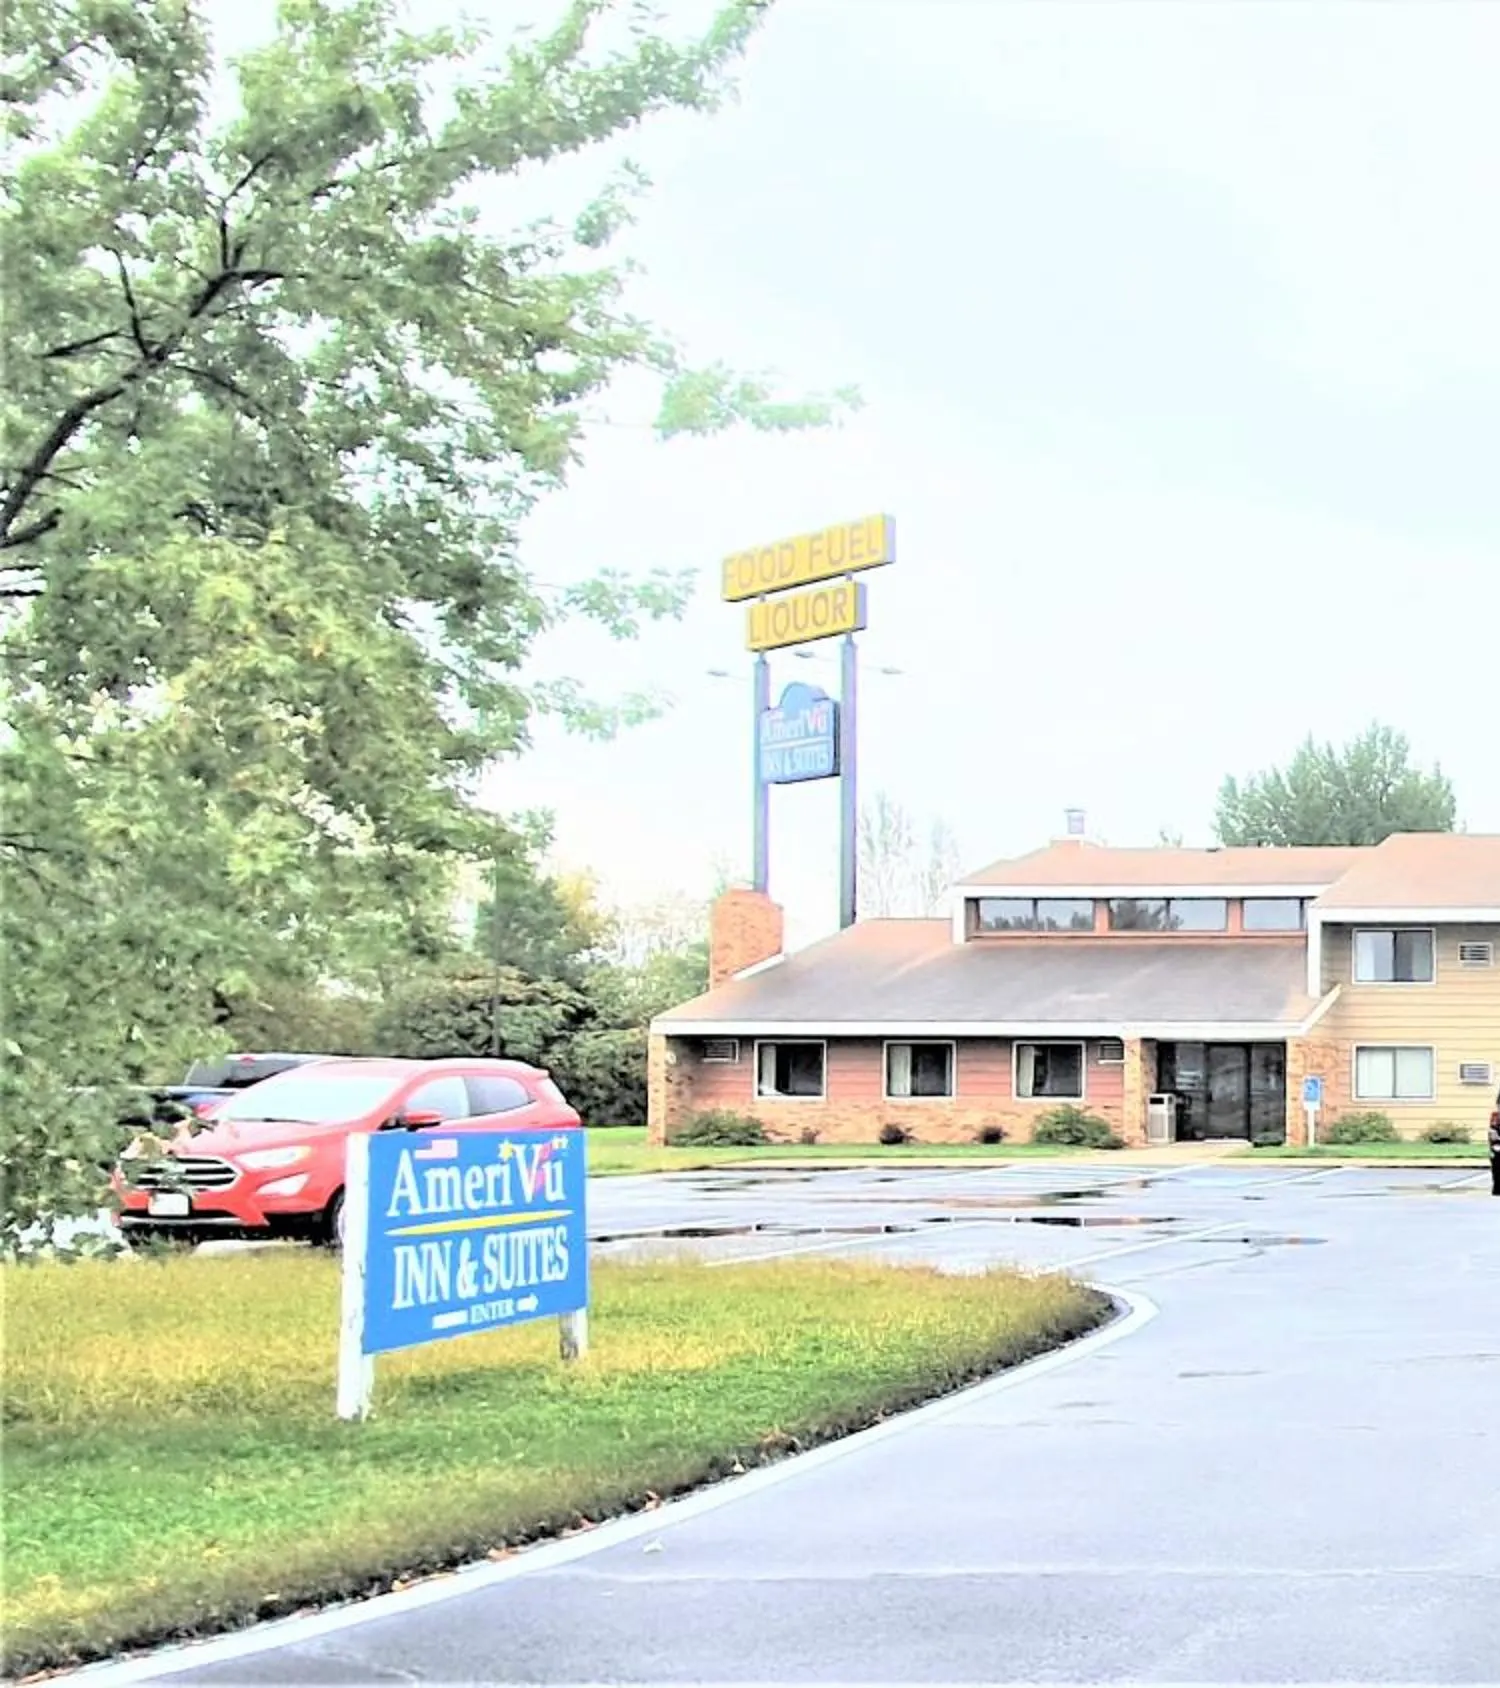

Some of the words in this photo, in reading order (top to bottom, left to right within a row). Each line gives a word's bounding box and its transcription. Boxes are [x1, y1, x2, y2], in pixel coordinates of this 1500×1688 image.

[722, 542, 795, 592] FOOD
[809, 519, 880, 573] FUEL
[749, 587, 848, 642] LIQUOR
[392, 1239, 452, 1309] INN
[456, 1237, 478, 1299] &
[482, 1225, 568, 1294] SUITES
[471, 1299, 514, 1324] ENTER
